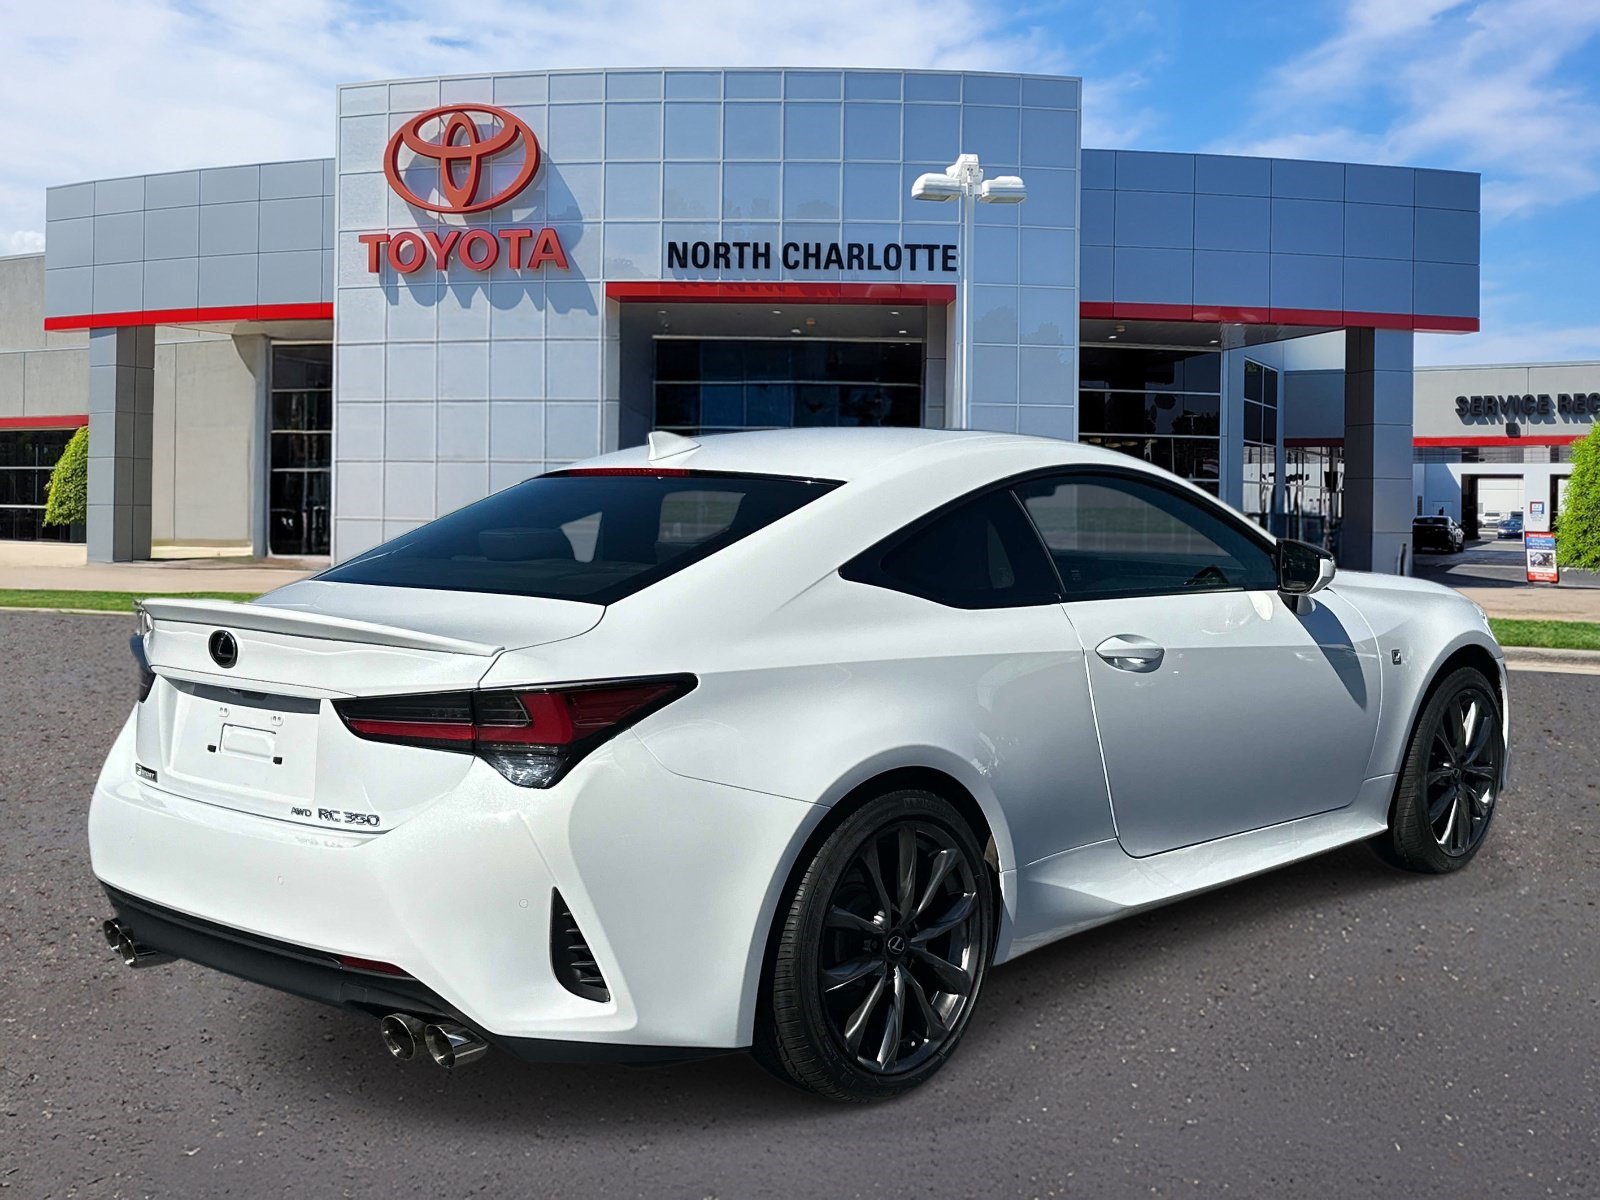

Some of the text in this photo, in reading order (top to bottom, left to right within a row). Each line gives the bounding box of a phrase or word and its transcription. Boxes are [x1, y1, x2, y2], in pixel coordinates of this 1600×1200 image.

[359, 228, 569, 273] TOYOTA
[667, 241, 957, 272] NORTH CHARLOTTE
[1455, 393, 1550, 417] SERVICE
[291, 806, 380, 828] AWD RC 350
